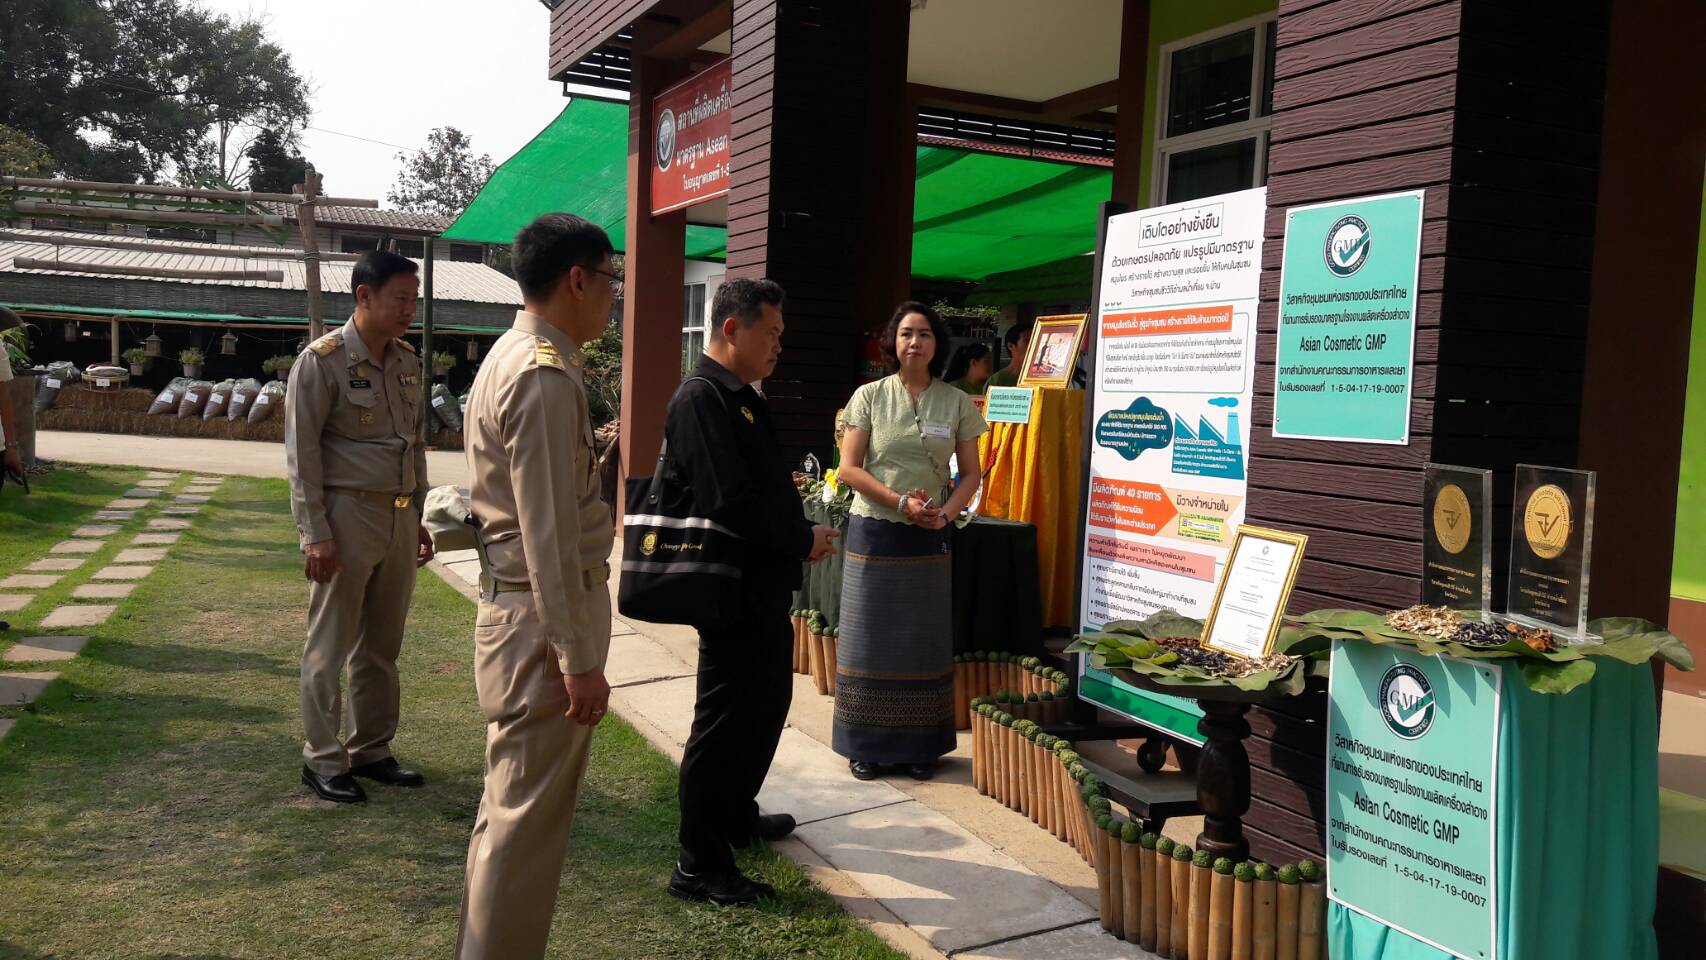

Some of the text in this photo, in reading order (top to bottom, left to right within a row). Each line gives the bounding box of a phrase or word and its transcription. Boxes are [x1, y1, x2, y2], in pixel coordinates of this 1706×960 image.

[676, 134, 728, 169] มาตรฐาน Asean
[1142, 209, 1220, 240] เติบโตอย่างยั่งยืน
[1111, 238, 1254, 268] ด้วยเกษตรปลอดภัย แปรรูปมีมาตรฐาน
[1286, 285, 1407, 306] วิสาหกิจชุมชนแห่งแรกของประเทศไทย
[1299, 333, 1387, 352] Asian Cosmetic GMP
[1279, 381, 1405, 395] ใบรับรองเลขที่ 1-5-04-17-19-0007
[1127, 488, 1135, 498] 40
[1137, 491, 1162, 502] รายการ
[1176, 494, 1229, 512] มีวางจำหน่ายใน
[1390, 689, 1424, 711] GMP
[1335, 733, 1483, 793] วิสาหกิจชุมชนแห่งแรกของประเทศไทย
[1354, 791, 1460, 845] Asian Cosmetic GMP
[1331, 818, 1486, 887] จากสำนักงานคณะกรรมการอาหารและยา
[1331, 836, 1487, 908] ใบรับรองเลขที่ 1-5-04-17-19-0007
